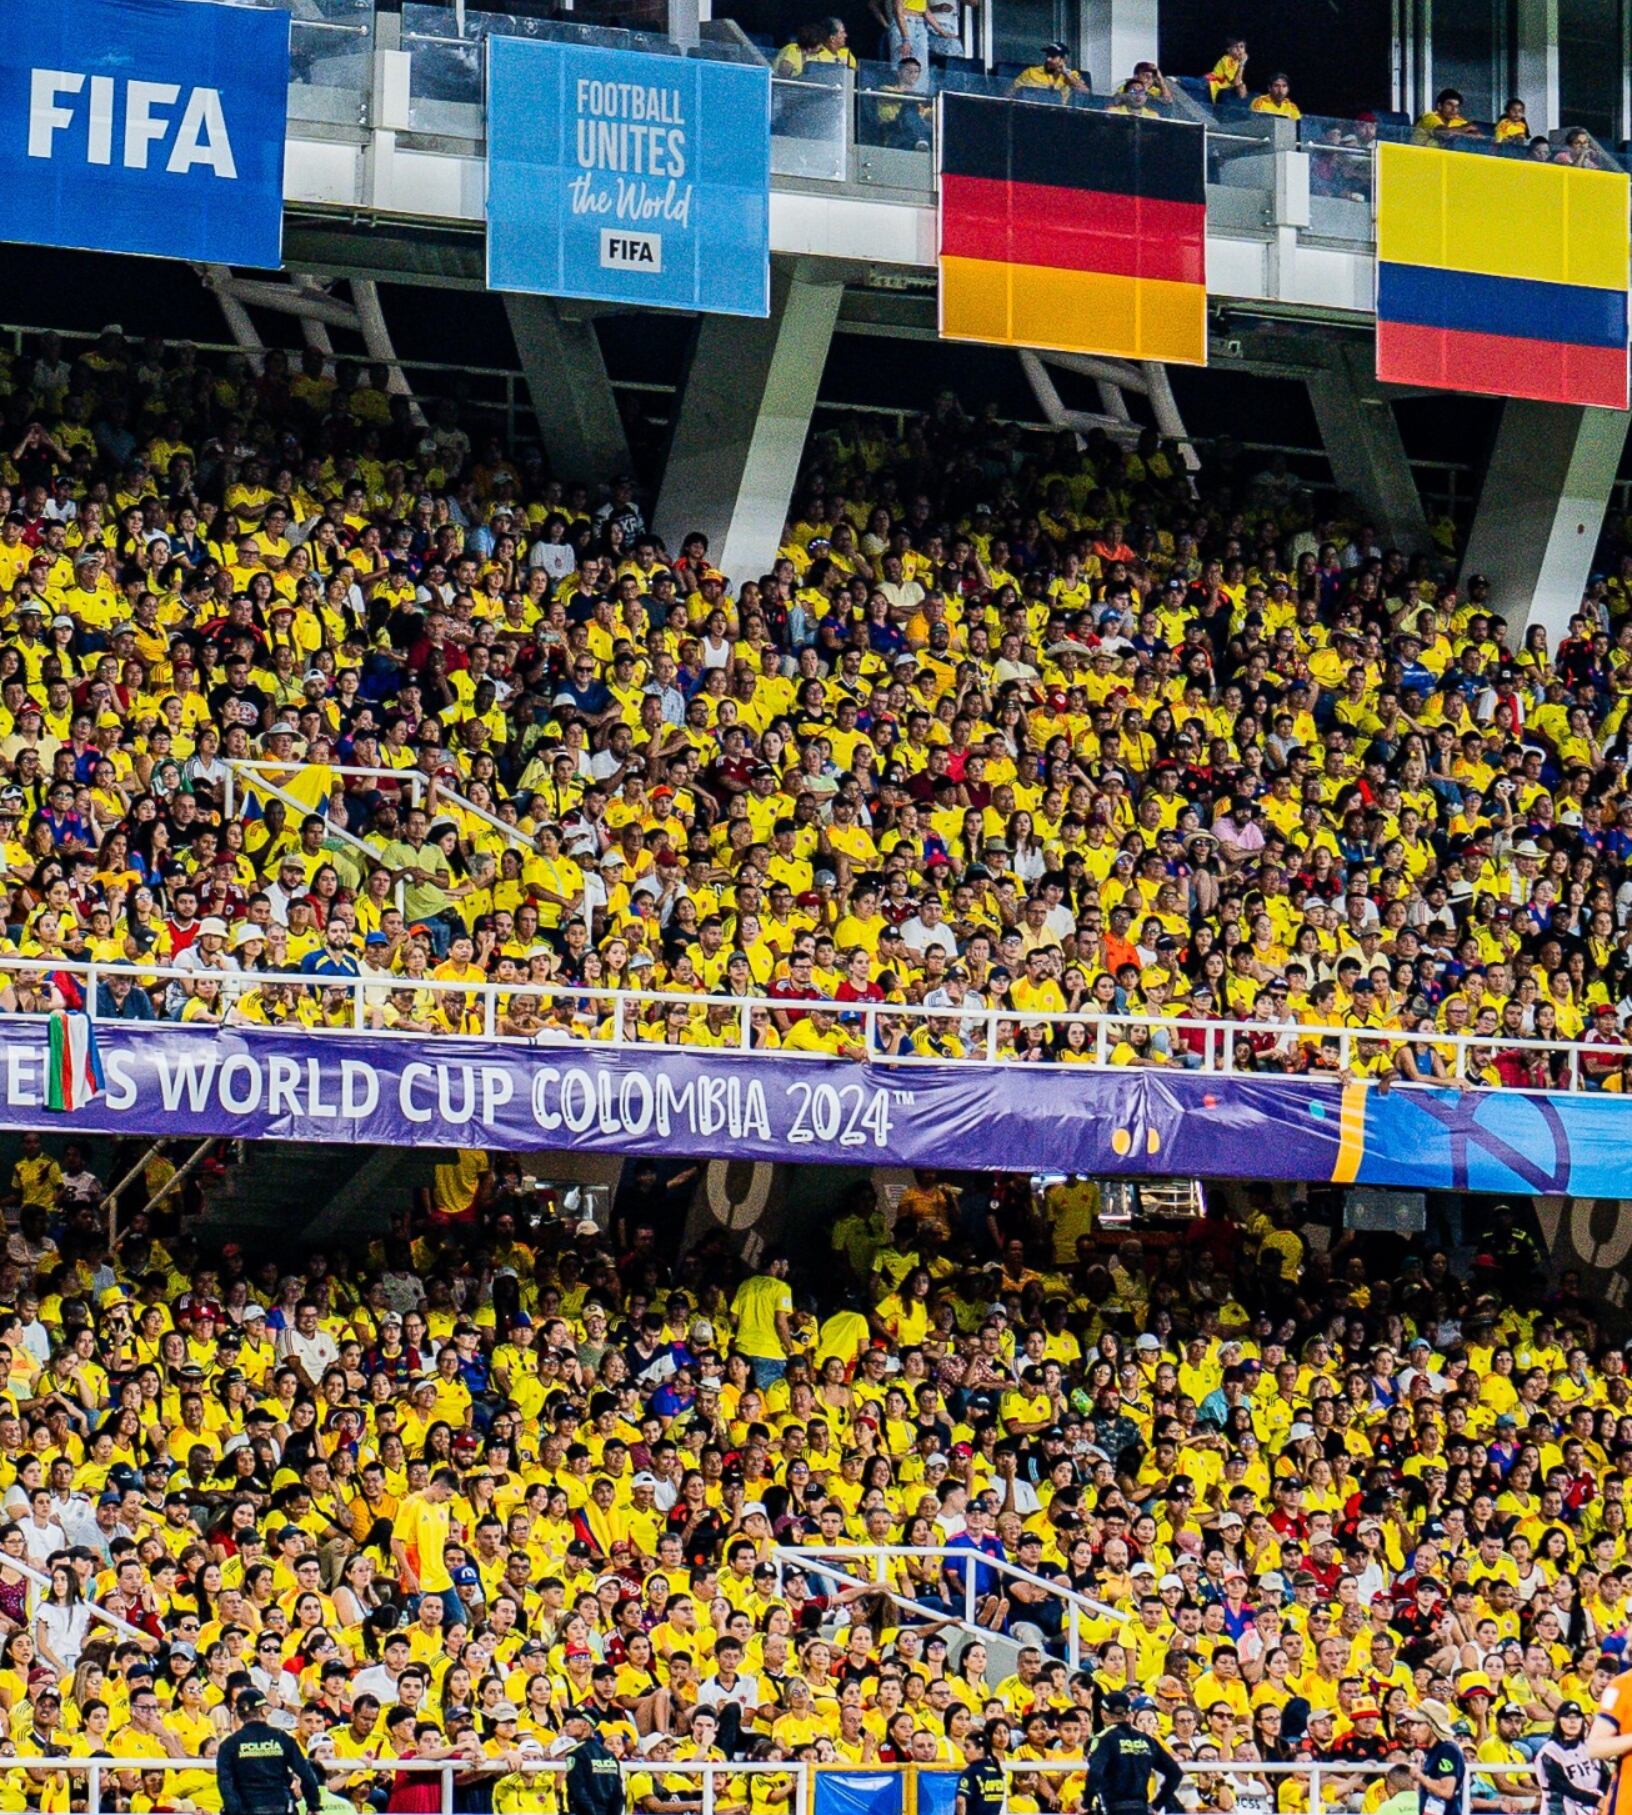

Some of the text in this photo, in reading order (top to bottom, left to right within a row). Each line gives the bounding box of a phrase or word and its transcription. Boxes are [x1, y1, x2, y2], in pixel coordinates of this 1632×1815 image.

[28, 68, 237, 180] FIFA
[576, 78, 685, 125] FOOTBALL
[576, 120, 685, 178] UNITES
[568, 173, 692, 230] the World
[608, 238, 654, 263] FIFA
[154, 1050, 380, 1120] WORLD
[398, 1060, 514, 1126] CUP
[531, 1066, 772, 1142] COLOMBIA
[240, 1739, 282, 1753] POLICÍA
